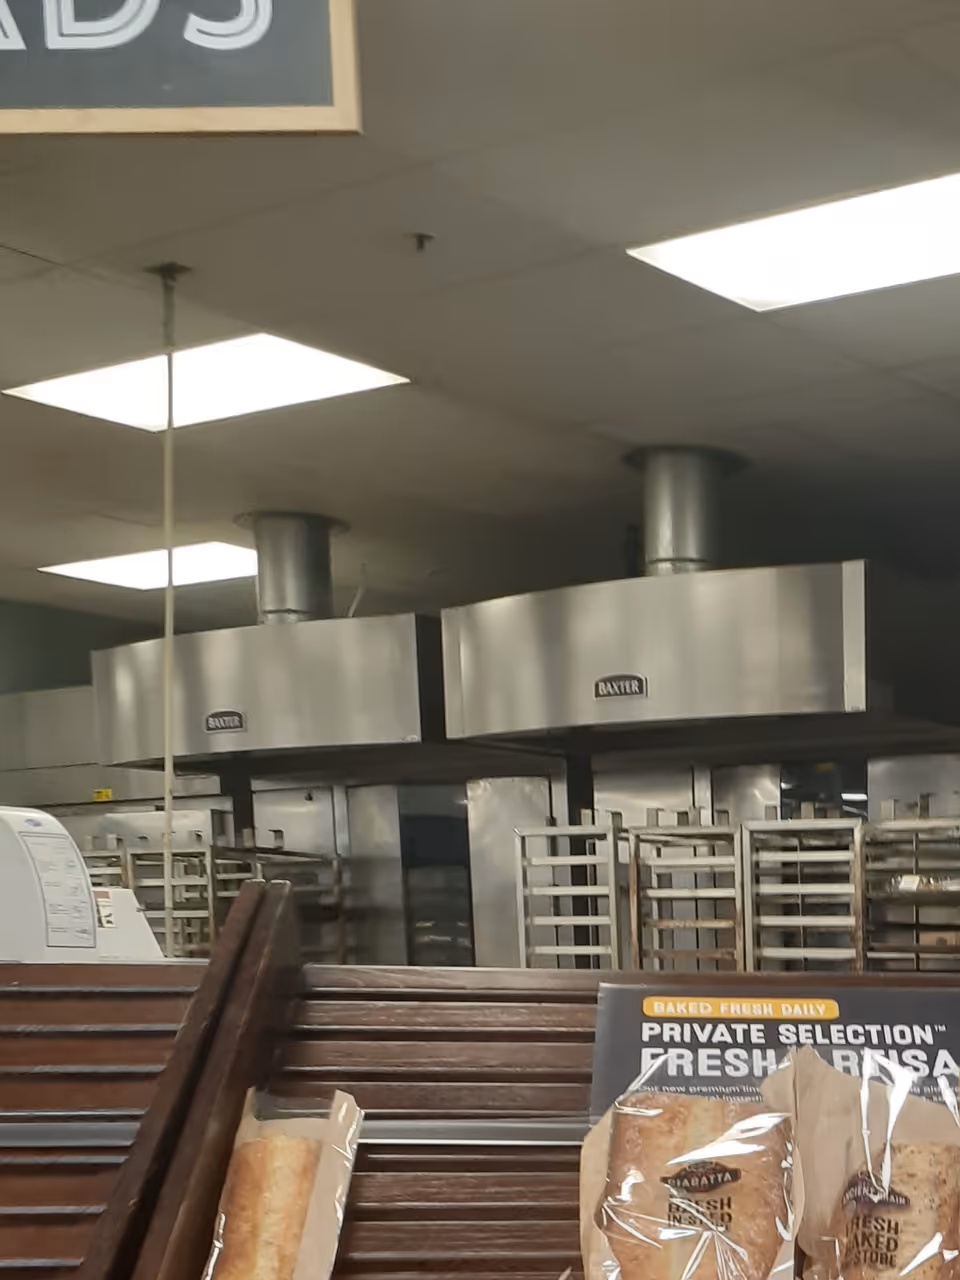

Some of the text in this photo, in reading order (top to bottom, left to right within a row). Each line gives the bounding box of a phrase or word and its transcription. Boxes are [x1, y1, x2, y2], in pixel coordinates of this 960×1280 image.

[598, 680, 640, 696] BAXTER
[653, 1001, 827, 1018] BAKED FRESH DAILY
[641, 1021, 767, 1044] PRIVATE
